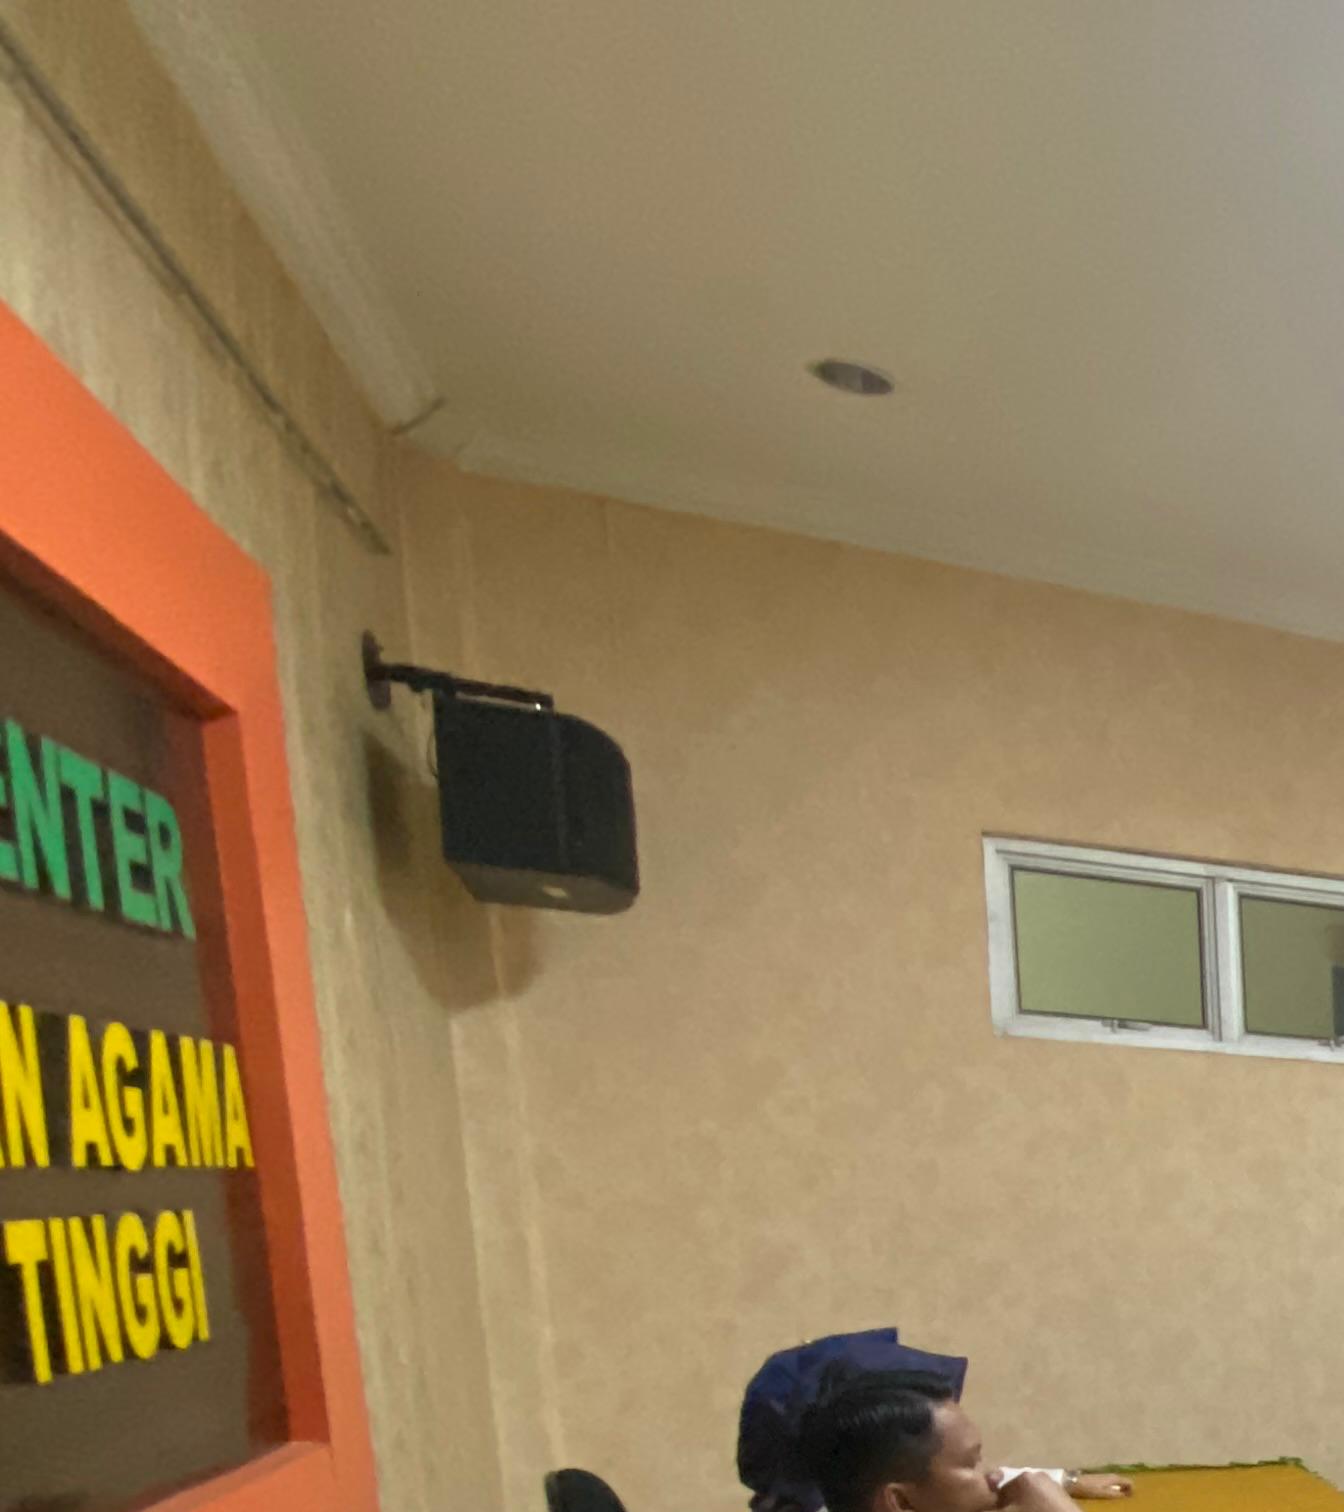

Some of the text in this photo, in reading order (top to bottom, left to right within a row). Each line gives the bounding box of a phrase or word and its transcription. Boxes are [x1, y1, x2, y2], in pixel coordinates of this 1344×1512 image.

[0, 999, 255, 1171] N AGAMA
[3, 1209, 210, 1385] TINGGI
